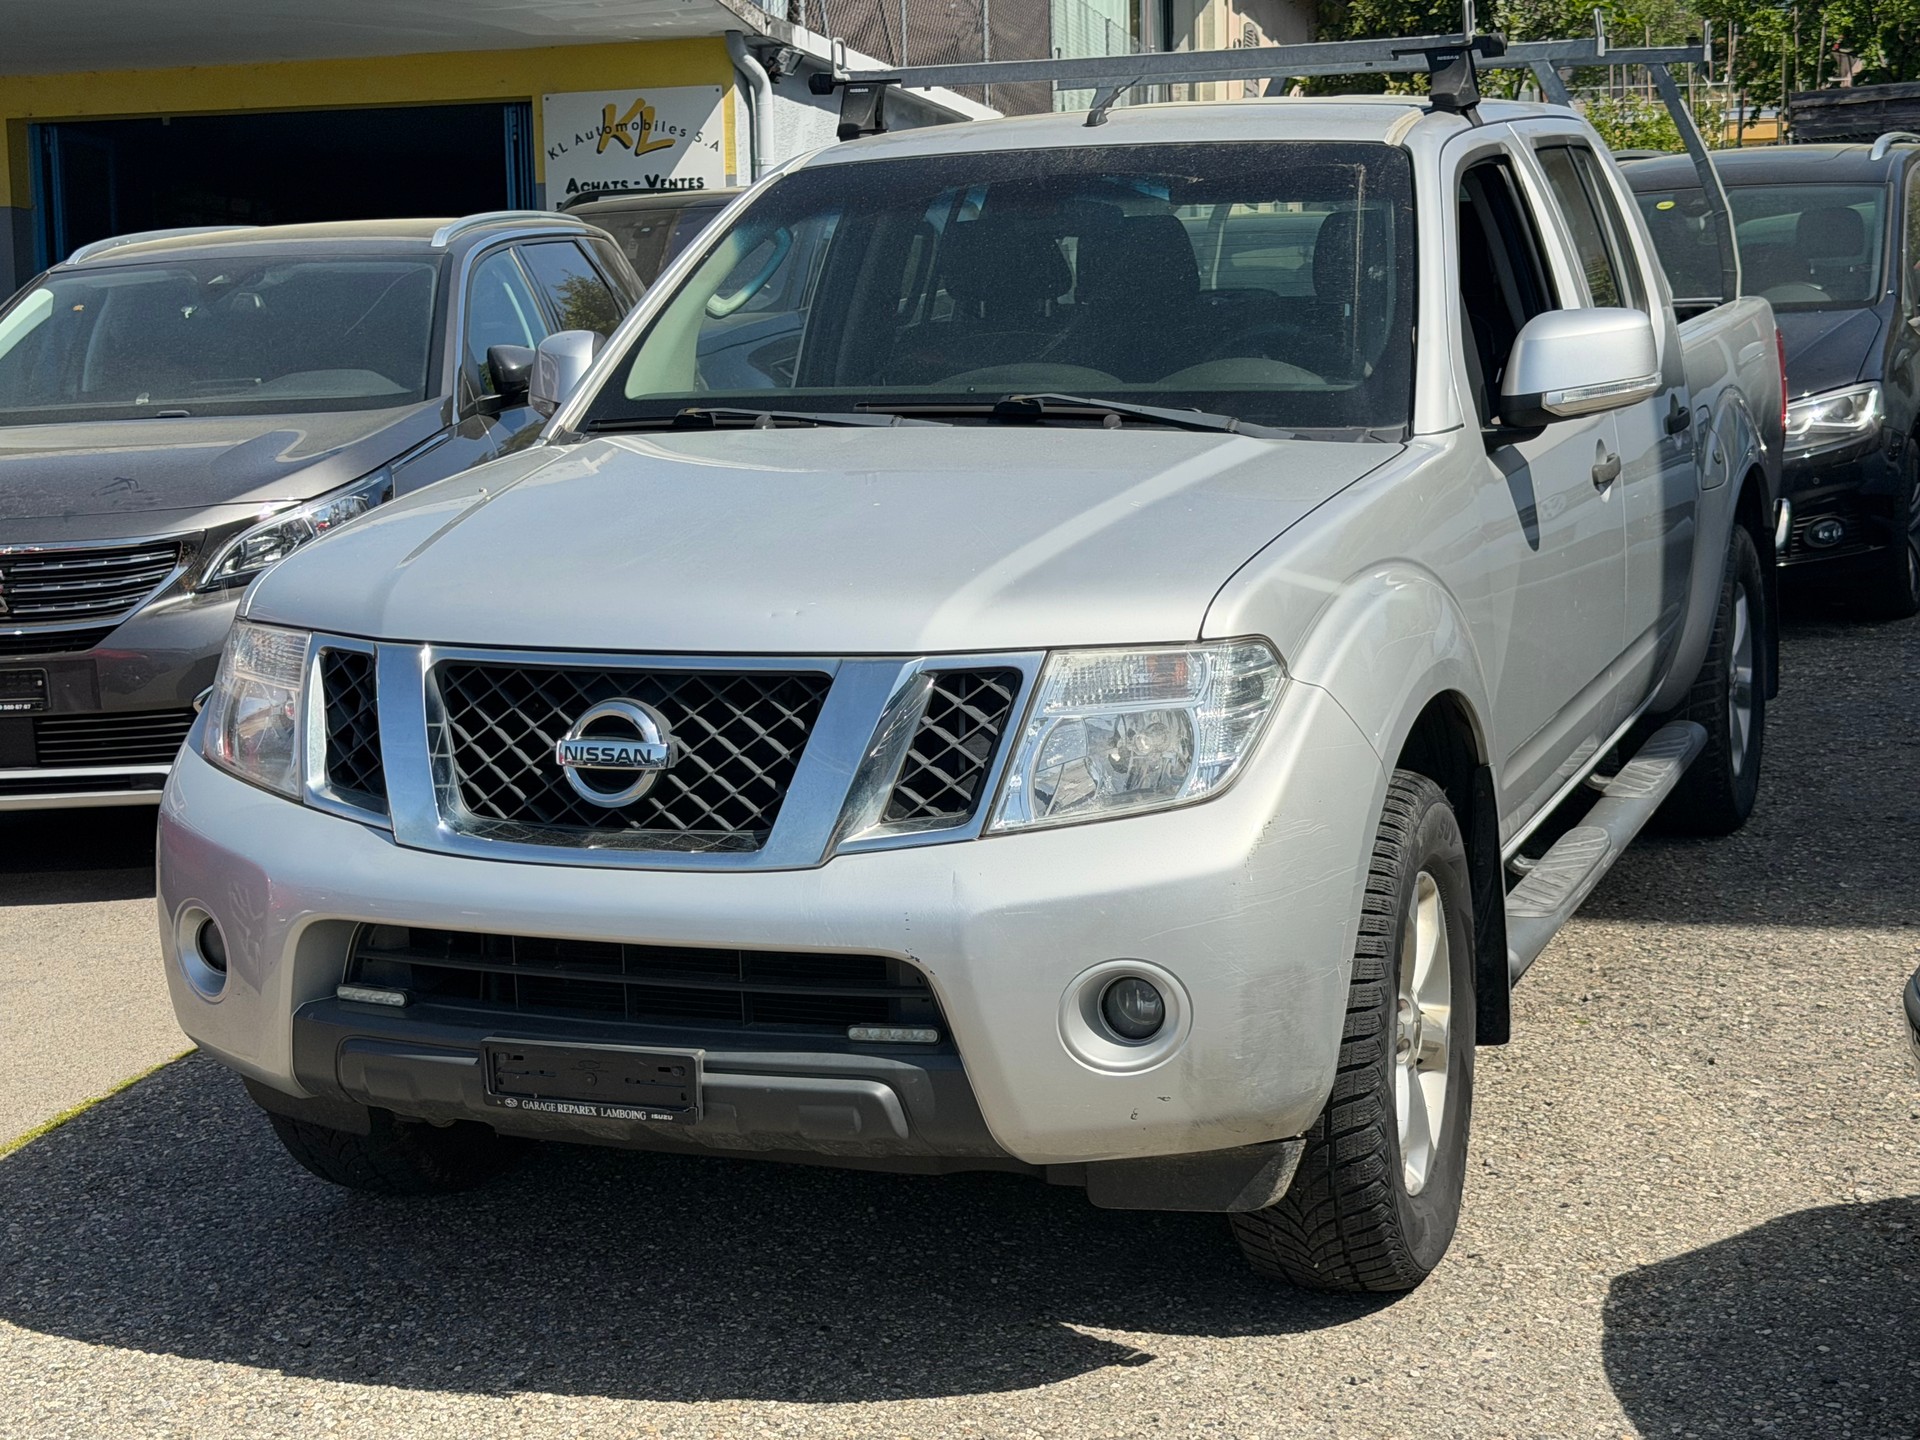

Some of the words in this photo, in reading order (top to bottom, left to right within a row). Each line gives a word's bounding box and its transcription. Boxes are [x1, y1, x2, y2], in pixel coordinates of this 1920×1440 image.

[547, 142, 569, 160] KL
[575, 120, 687, 146] Automobiles
[694, 131, 719, 152] S.A
[595, 97, 677, 157] KL
[564, 745, 652, 764] NISSAN
[522, 1100, 557, 1113] GARAGE
[557, 1103, 598, 1116] REPAREX
[600, 1107, 647, 1121] LAMBOING
[650, 1113, 673, 1121] ISUZU
